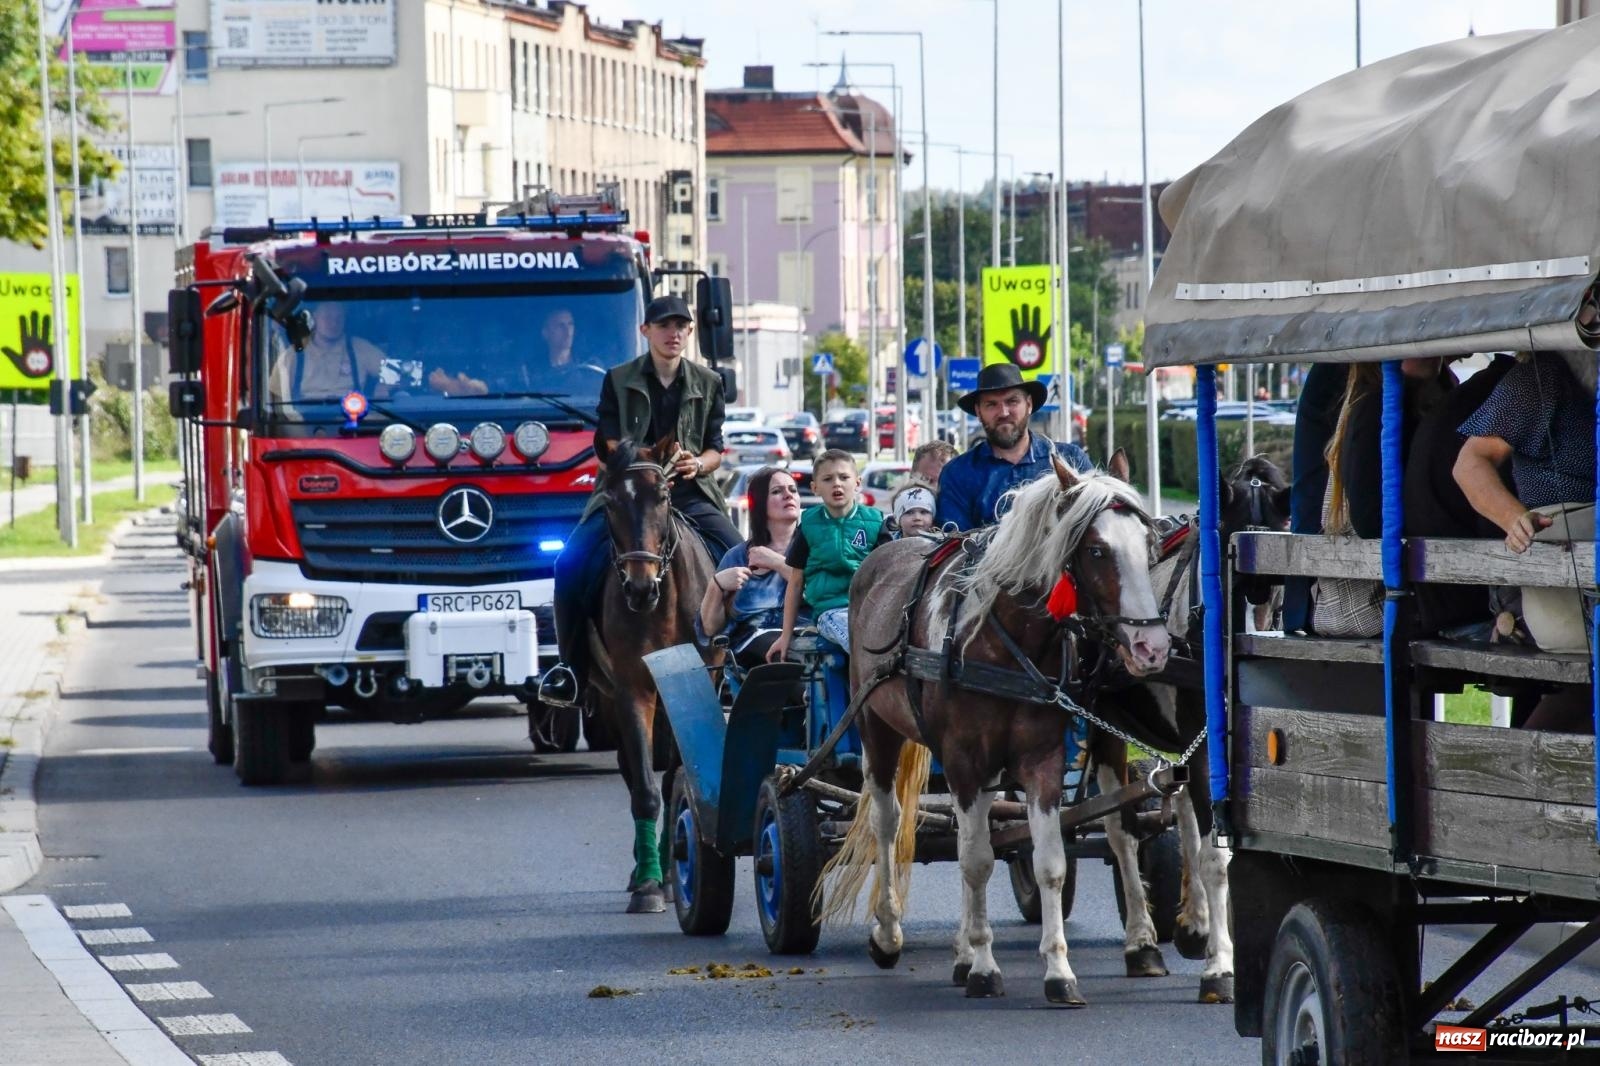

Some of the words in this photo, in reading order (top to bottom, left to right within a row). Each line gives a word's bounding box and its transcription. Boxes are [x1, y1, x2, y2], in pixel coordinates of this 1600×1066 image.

[254, 169, 353, 187] KLIMAYZACJI
[327, 252, 580, 276] RACIBÓRZ-MIEDONIA
[851, 529, 867, 548] A
[431, 596, 465, 612] SRC
[471, 594, 515, 611] PG62
